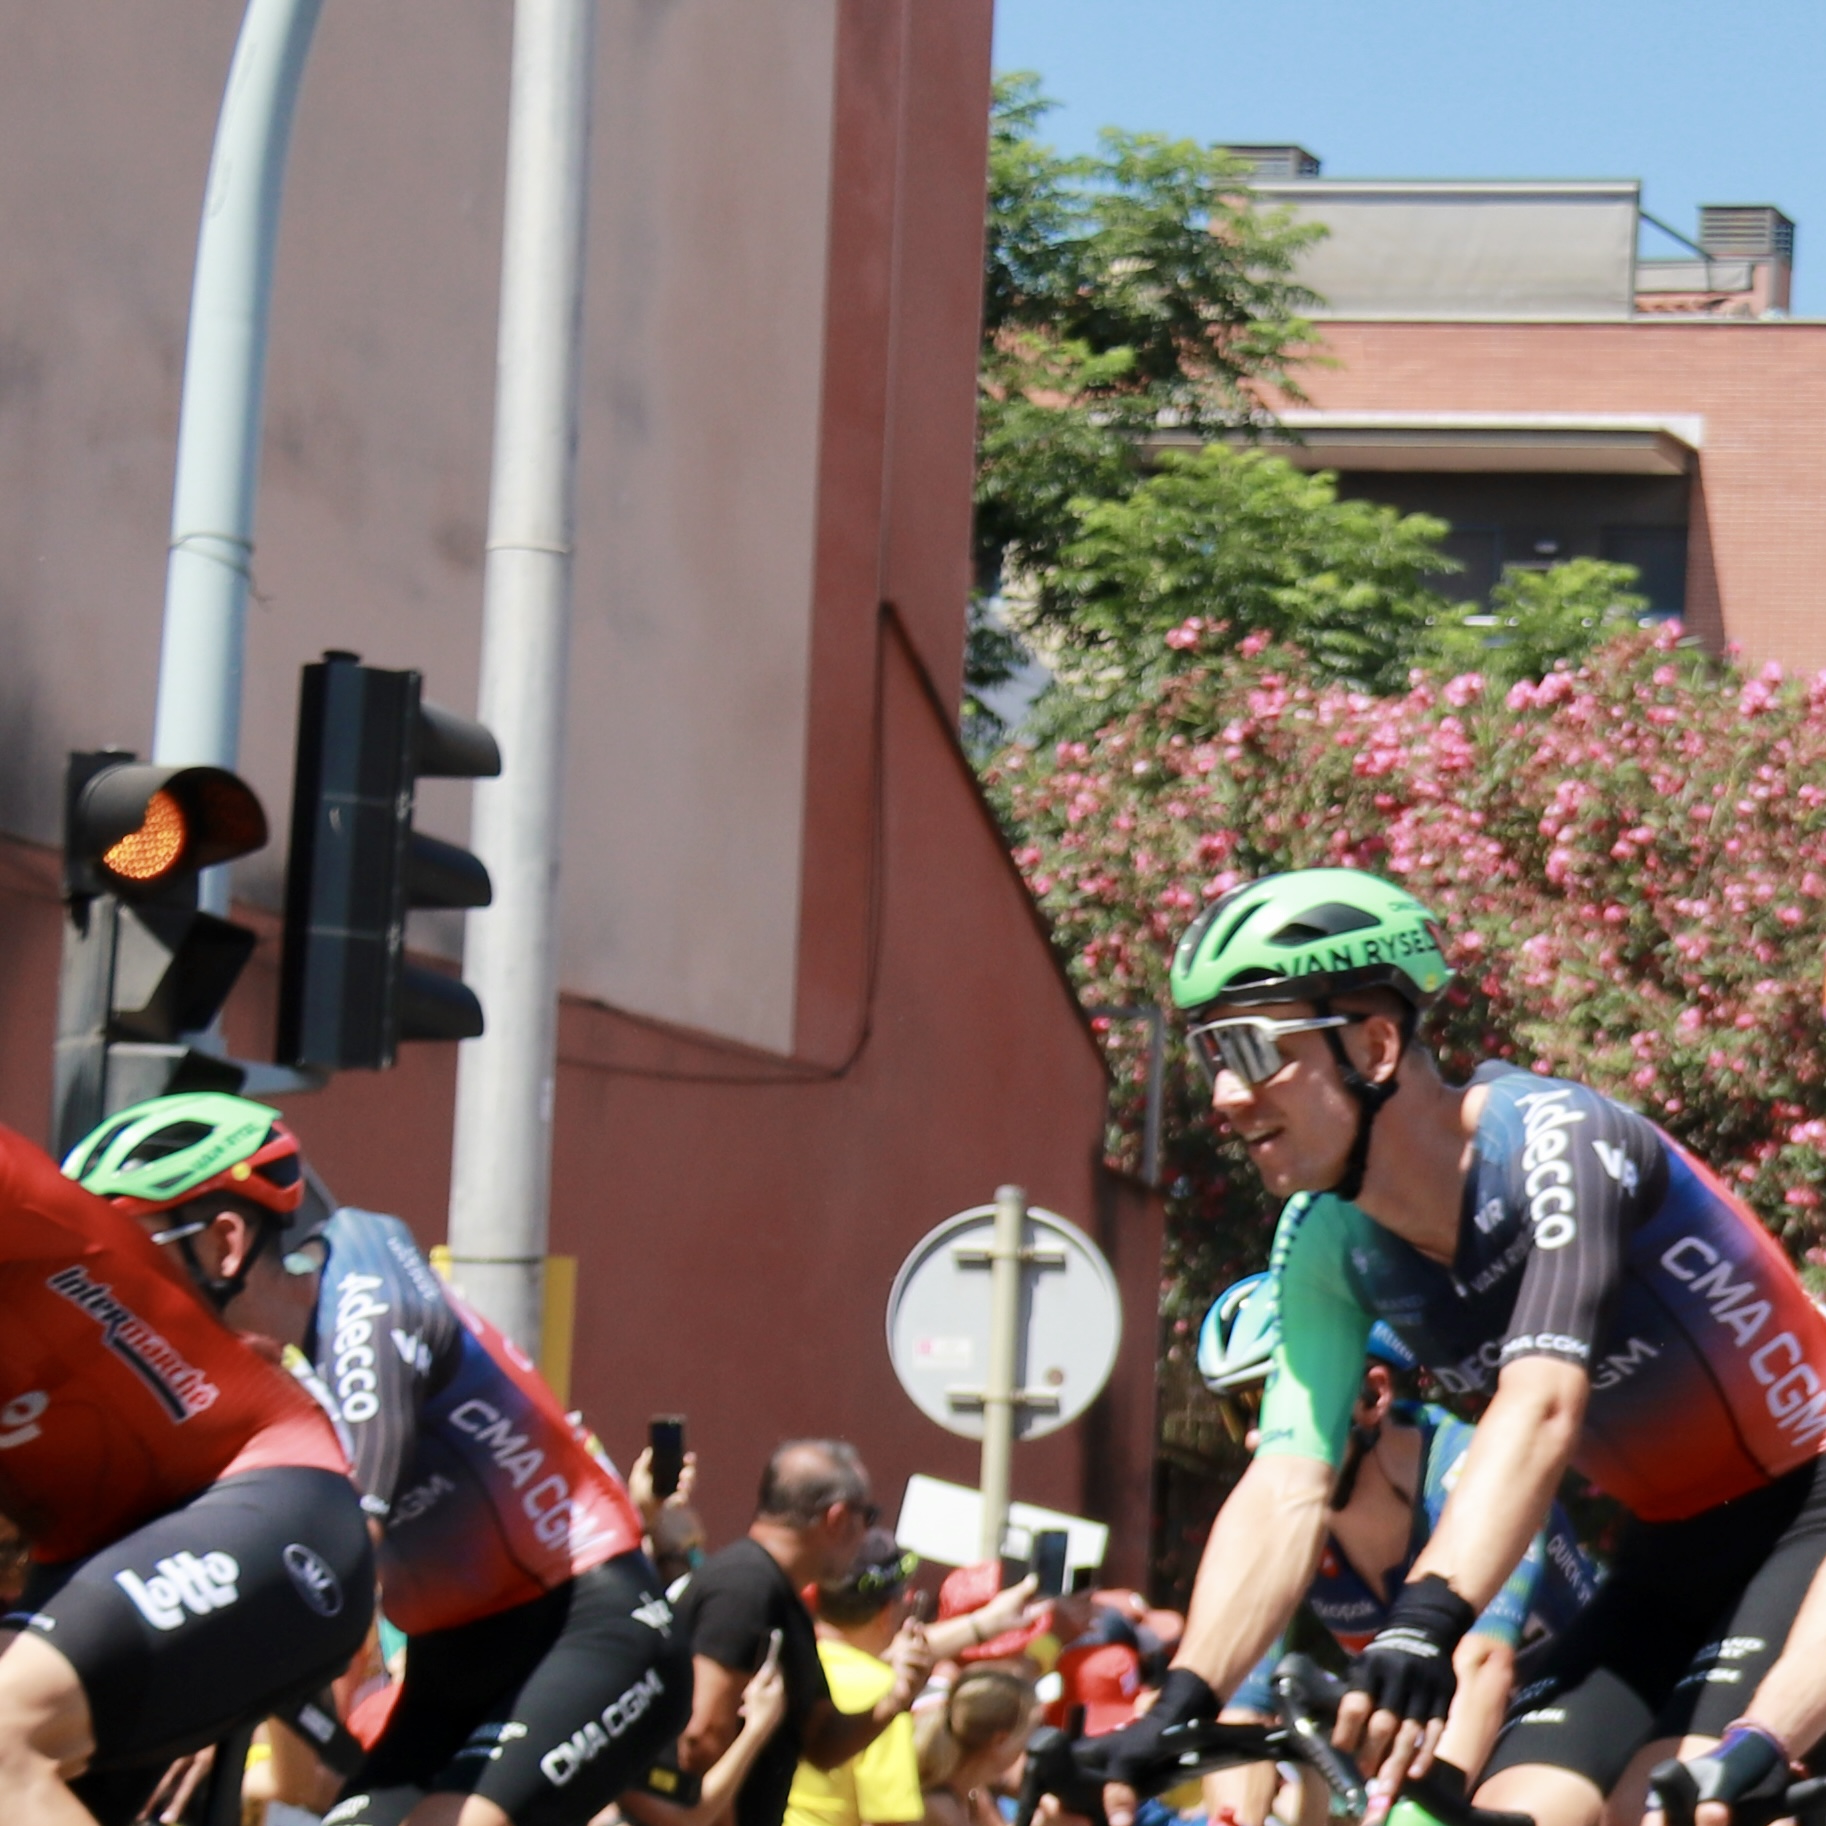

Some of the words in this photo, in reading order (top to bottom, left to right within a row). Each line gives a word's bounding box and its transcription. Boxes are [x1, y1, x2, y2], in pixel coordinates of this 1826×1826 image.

[1276, 944, 1354, 977] VAN
[1361, 928, 1440, 968] RYSEL
[1514, 1089, 1587, 1251] Adecco
[333, 1271, 390, 1423] Adecco
[1659, 1236, 1772, 1348] CMA
[1588, 1335, 1659, 1390] GM
[449, 1399, 546, 1489] CMA
[523, 1474, 617, 1572] CGM
